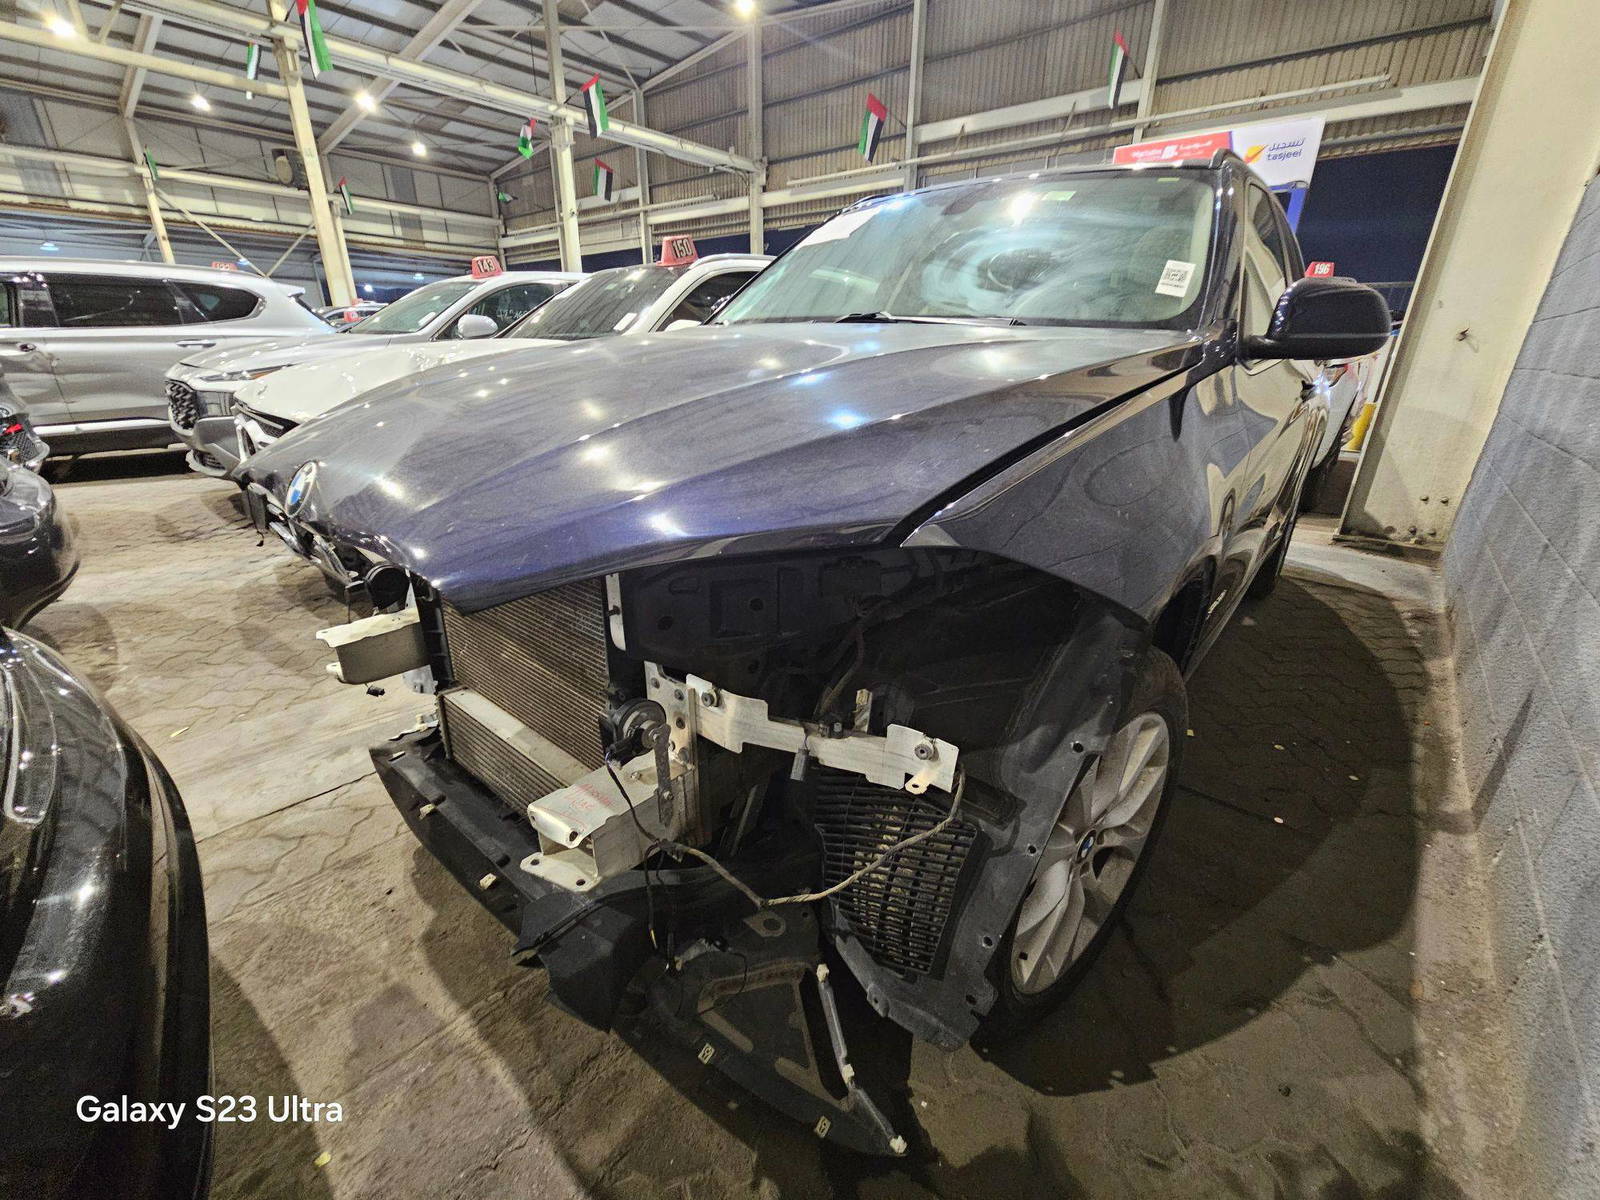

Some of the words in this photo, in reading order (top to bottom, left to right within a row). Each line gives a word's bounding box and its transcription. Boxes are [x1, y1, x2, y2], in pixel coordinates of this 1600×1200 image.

[1267, 149, 1302, 161] tasjeel
[671, 237, 694, 258] 150
[476, 259, 496, 273] 143
[1313, 262, 1331, 275] 196
